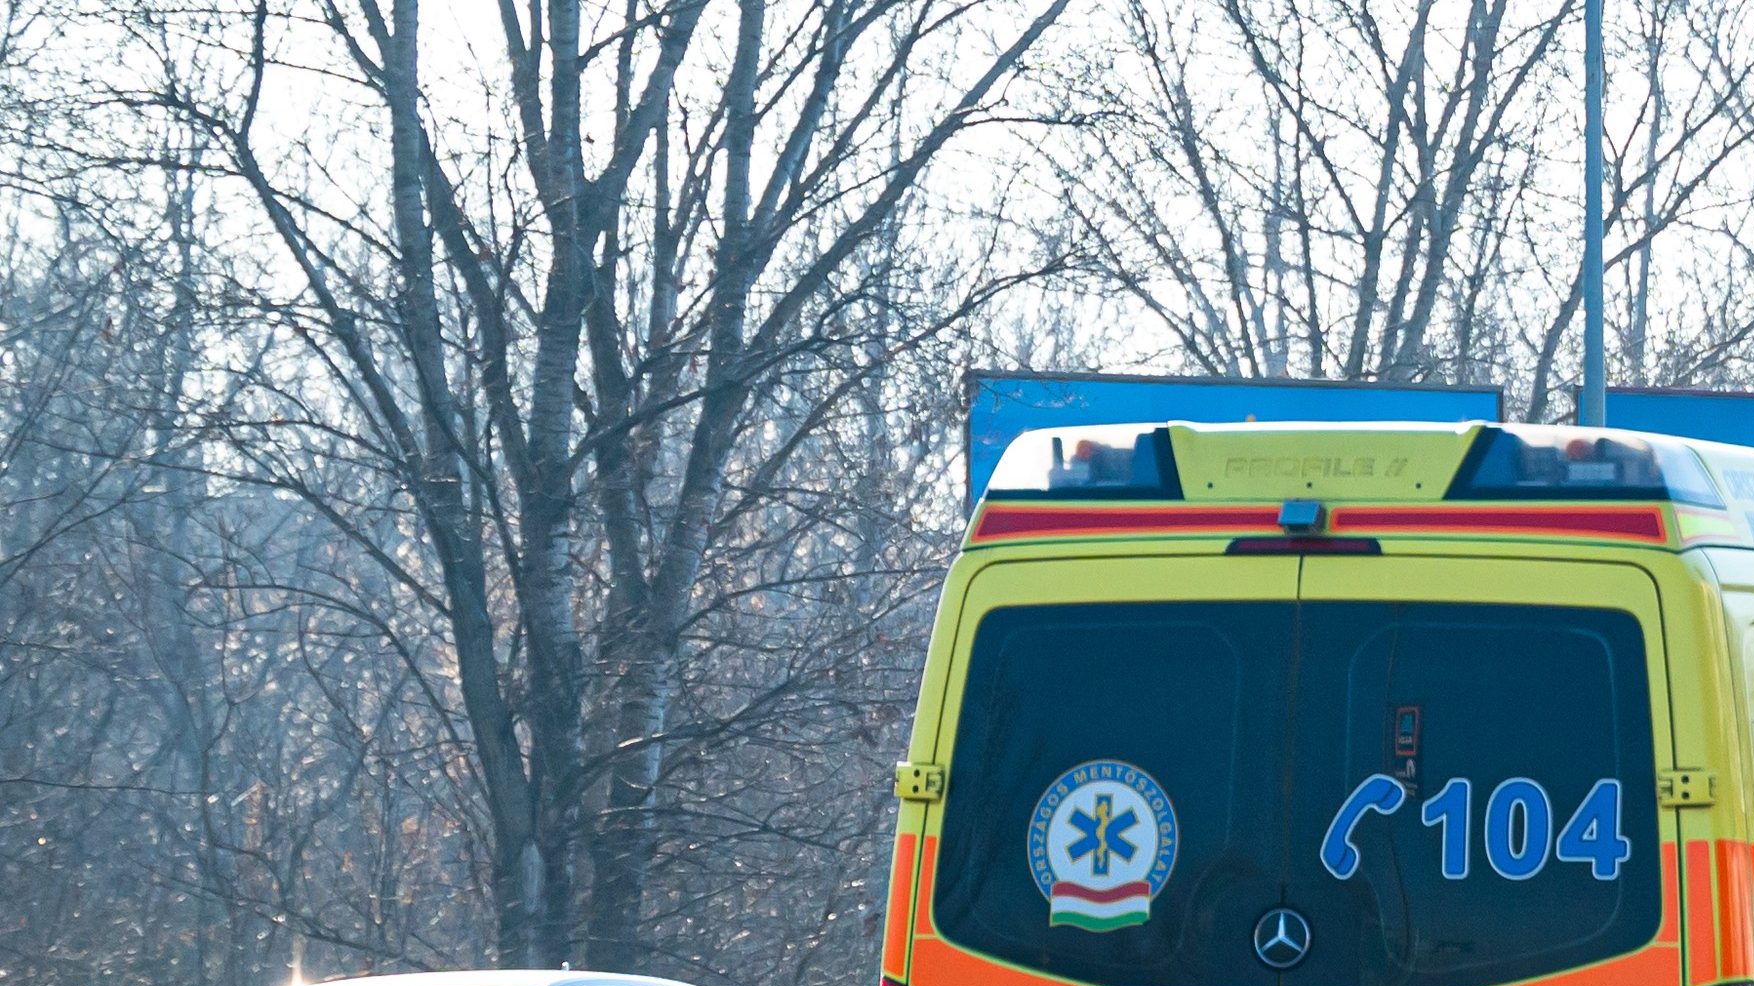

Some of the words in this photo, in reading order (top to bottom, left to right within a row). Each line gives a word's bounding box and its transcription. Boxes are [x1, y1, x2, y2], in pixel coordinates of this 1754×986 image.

[1225, 457, 1376, 478] PROFILE
[1032, 783, 1069, 885] ORSZÁGOS
[1421, 776, 1631, 881] 104
